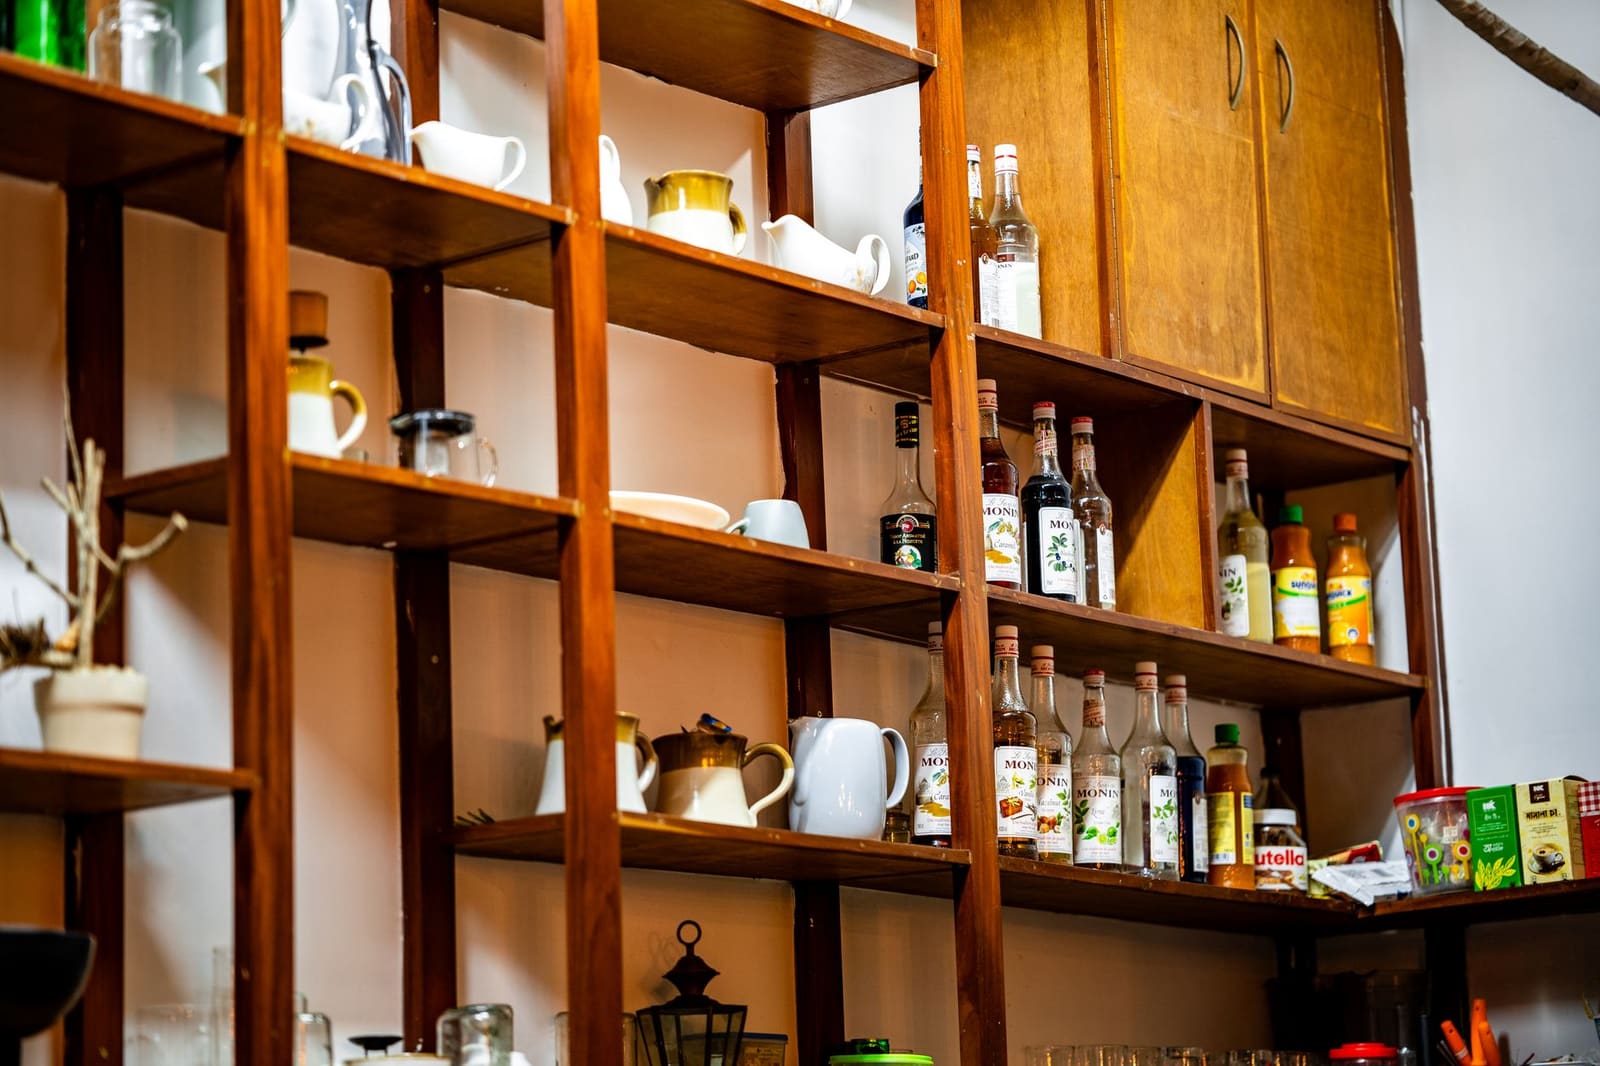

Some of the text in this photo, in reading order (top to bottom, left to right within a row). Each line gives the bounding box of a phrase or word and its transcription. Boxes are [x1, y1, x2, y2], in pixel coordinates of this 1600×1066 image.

[921, 757, 949, 768] MON
[1037, 777, 1068, 787] ONIN
[1077, 788, 1120, 799] MONIN
[1254, 848, 1305, 867] utella
